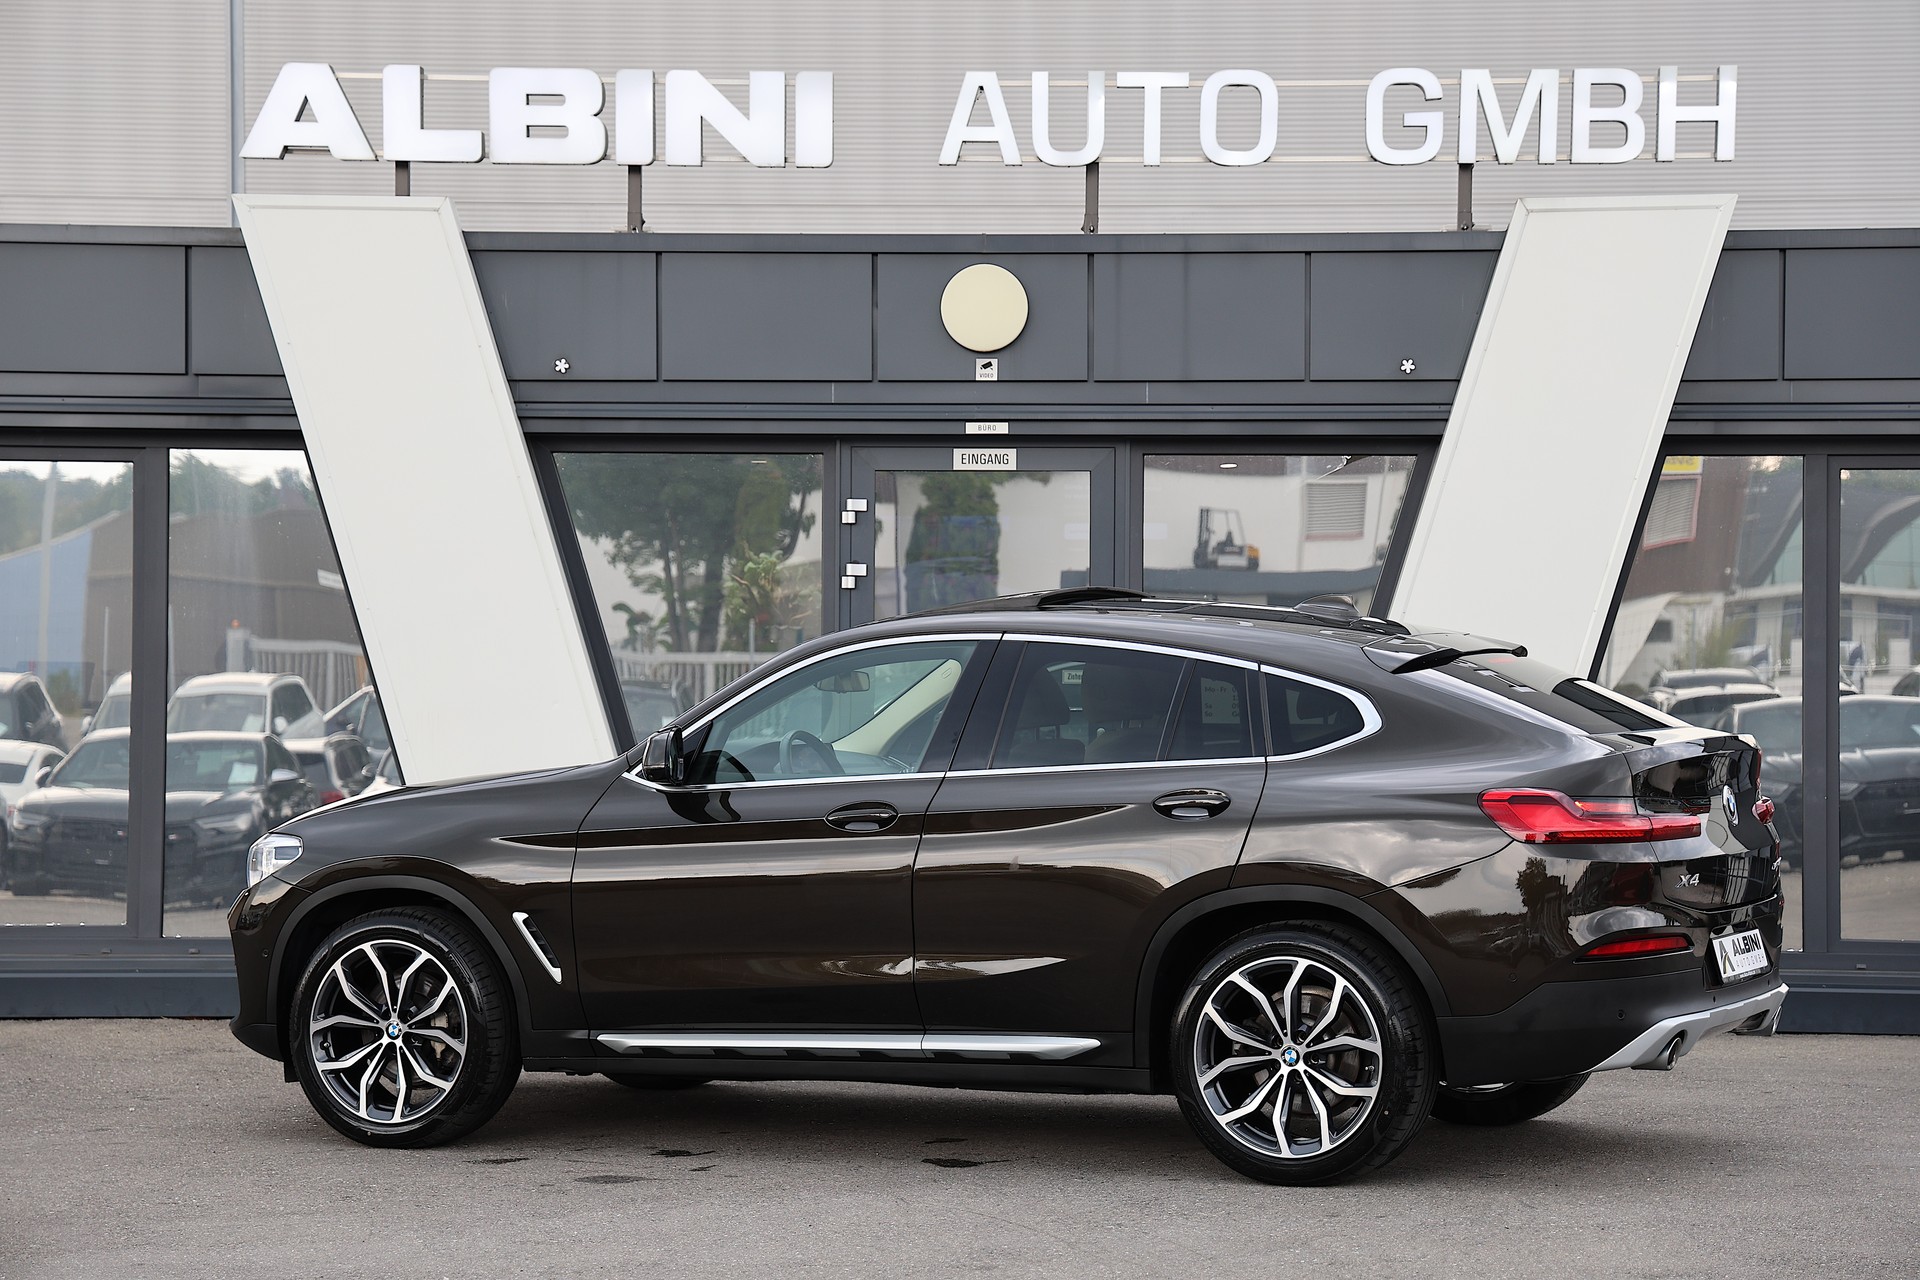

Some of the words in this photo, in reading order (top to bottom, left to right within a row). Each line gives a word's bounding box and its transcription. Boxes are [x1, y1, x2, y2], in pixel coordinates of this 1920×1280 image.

[241, 62, 834, 168] ALBINI
[938, 68, 1279, 167] AUTO
[1365, 65, 1739, 164] GMBH
[961, 453, 1009, 465] EINGANG
[1675, 873, 1700, 888] X4
[1732, 932, 1762, 957] ALBINI
